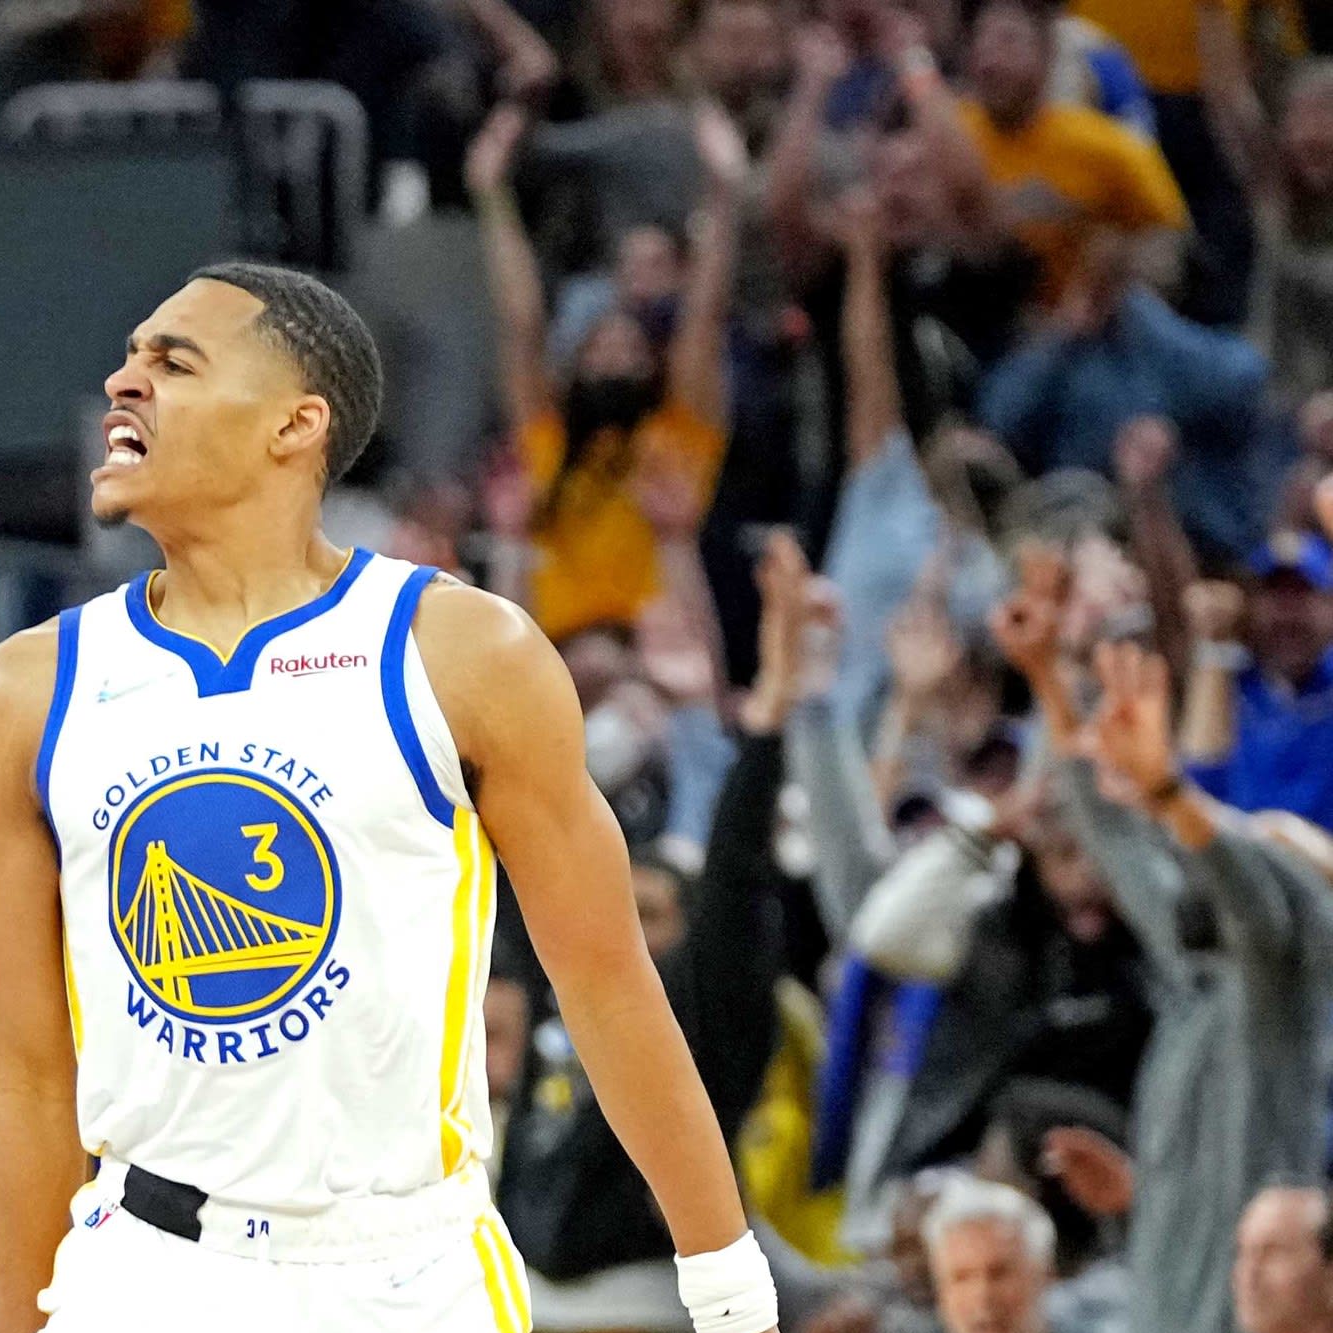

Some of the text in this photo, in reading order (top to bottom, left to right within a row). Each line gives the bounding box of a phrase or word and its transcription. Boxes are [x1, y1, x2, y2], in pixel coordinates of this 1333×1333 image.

[270, 652, 367, 676] Rakuten
[92, 741, 334, 832] GOLDEN STATE
[240, 822, 285, 892] 3
[125, 958, 352, 1065] WARRIORS
